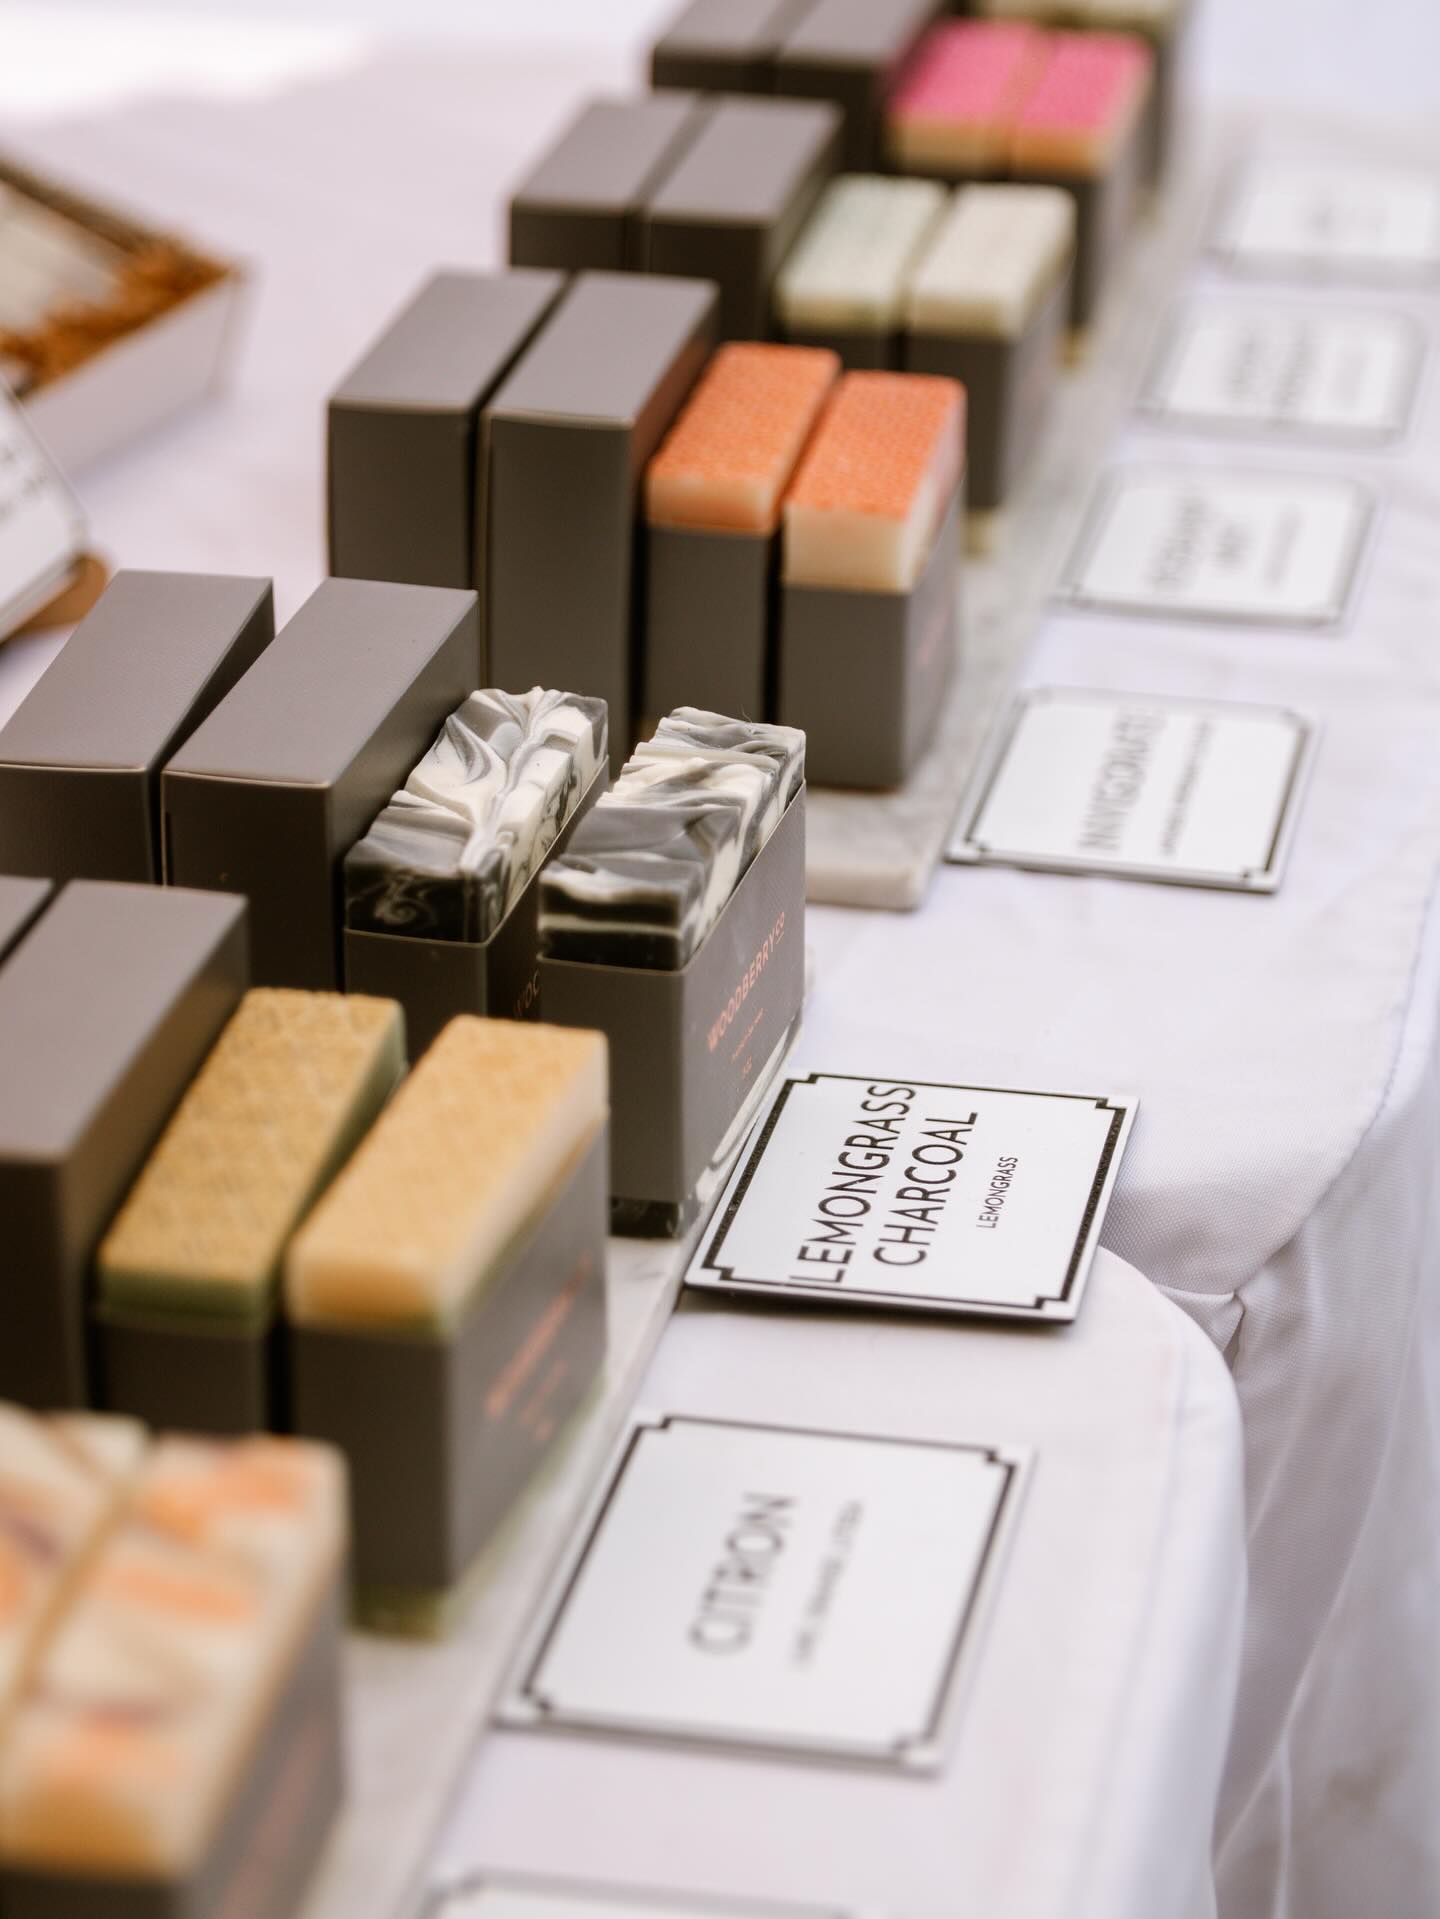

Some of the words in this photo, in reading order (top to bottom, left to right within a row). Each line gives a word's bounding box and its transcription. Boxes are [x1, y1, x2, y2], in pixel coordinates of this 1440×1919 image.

[789, 1085, 916, 1283] LEMONGRASS
[873, 1112, 978, 1266] CHARCOAL
[976, 1156, 1019, 1229] LEMONGRASS
[687, 1490, 798, 1656] CITRON
